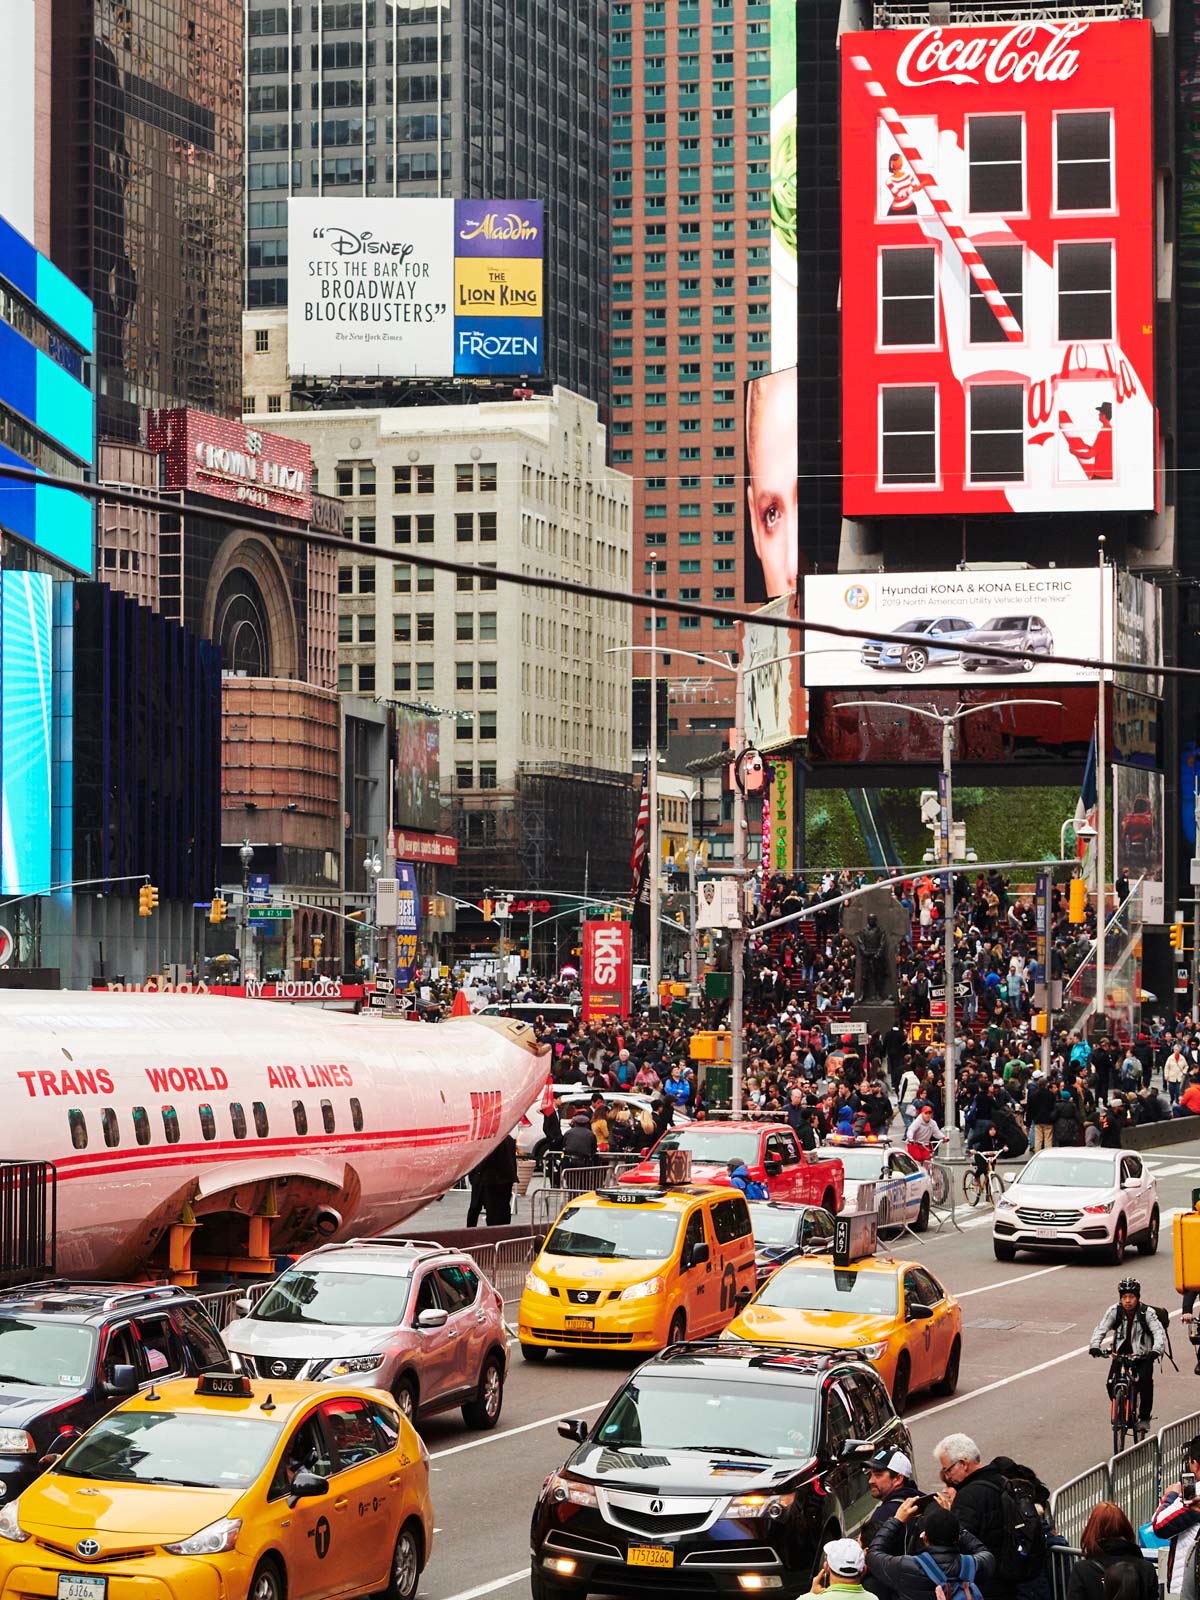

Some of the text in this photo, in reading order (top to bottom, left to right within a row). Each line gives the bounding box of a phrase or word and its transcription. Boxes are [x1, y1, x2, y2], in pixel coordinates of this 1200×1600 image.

[896, 21, 1089, 87] Coca-Cola
[460, 213, 537, 241] Aladdin
[308, 261, 430, 278] SETS THE BAR FOR
[488, 272, 506, 281] THE
[321, 279, 417, 300] BROADWAY
[459, 284, 537, 306] LION KING
[459, 331, 538, 360] FROZEN
[881, 581, 1072, 597] Hyundai KONA & KONA ELECTRIC
[881, 598, 901, 607] 2019
[902, 598, 927, 607] North
[928, 597, 968, 606] American
[776, 769, 788, 821] OLIVE
[594, 926, 624, 985] tkts
[245, 981, 342, 998] NY HOTDOGS
[17, 1068, 116, 1098] TRANS
[144, 1066, 229, 1093] WORLD
[616, 1195, 636, 1203] 2G33
[837, 1222, 846, 1253] 4M67
[212, 1379, 234, 1392] 6J26
[632, 1549, 669, 1564] T757326C
